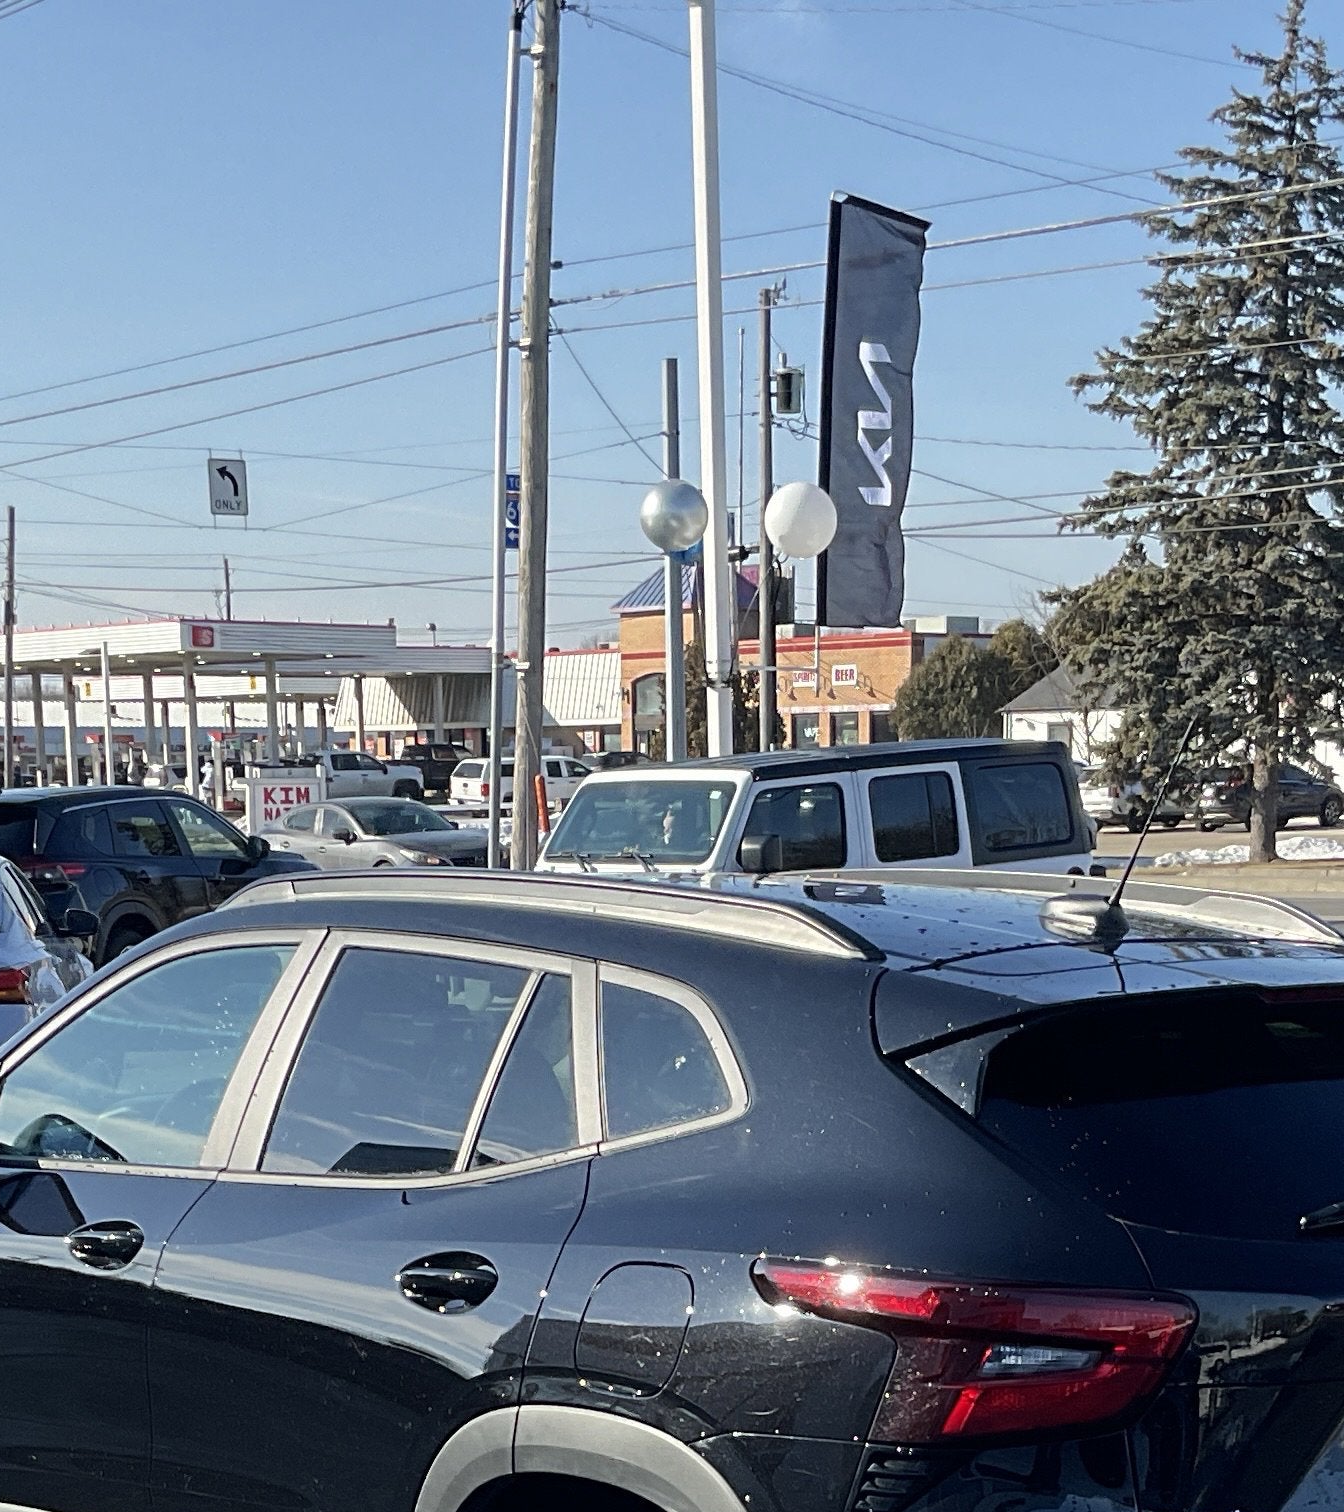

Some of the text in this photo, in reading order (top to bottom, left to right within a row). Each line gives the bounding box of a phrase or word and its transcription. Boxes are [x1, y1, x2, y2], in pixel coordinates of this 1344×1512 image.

[215, 499, 242, 511] ONLY
[834, 668, 855, 682] BEER
[263, 786, 311, 805] KIM
